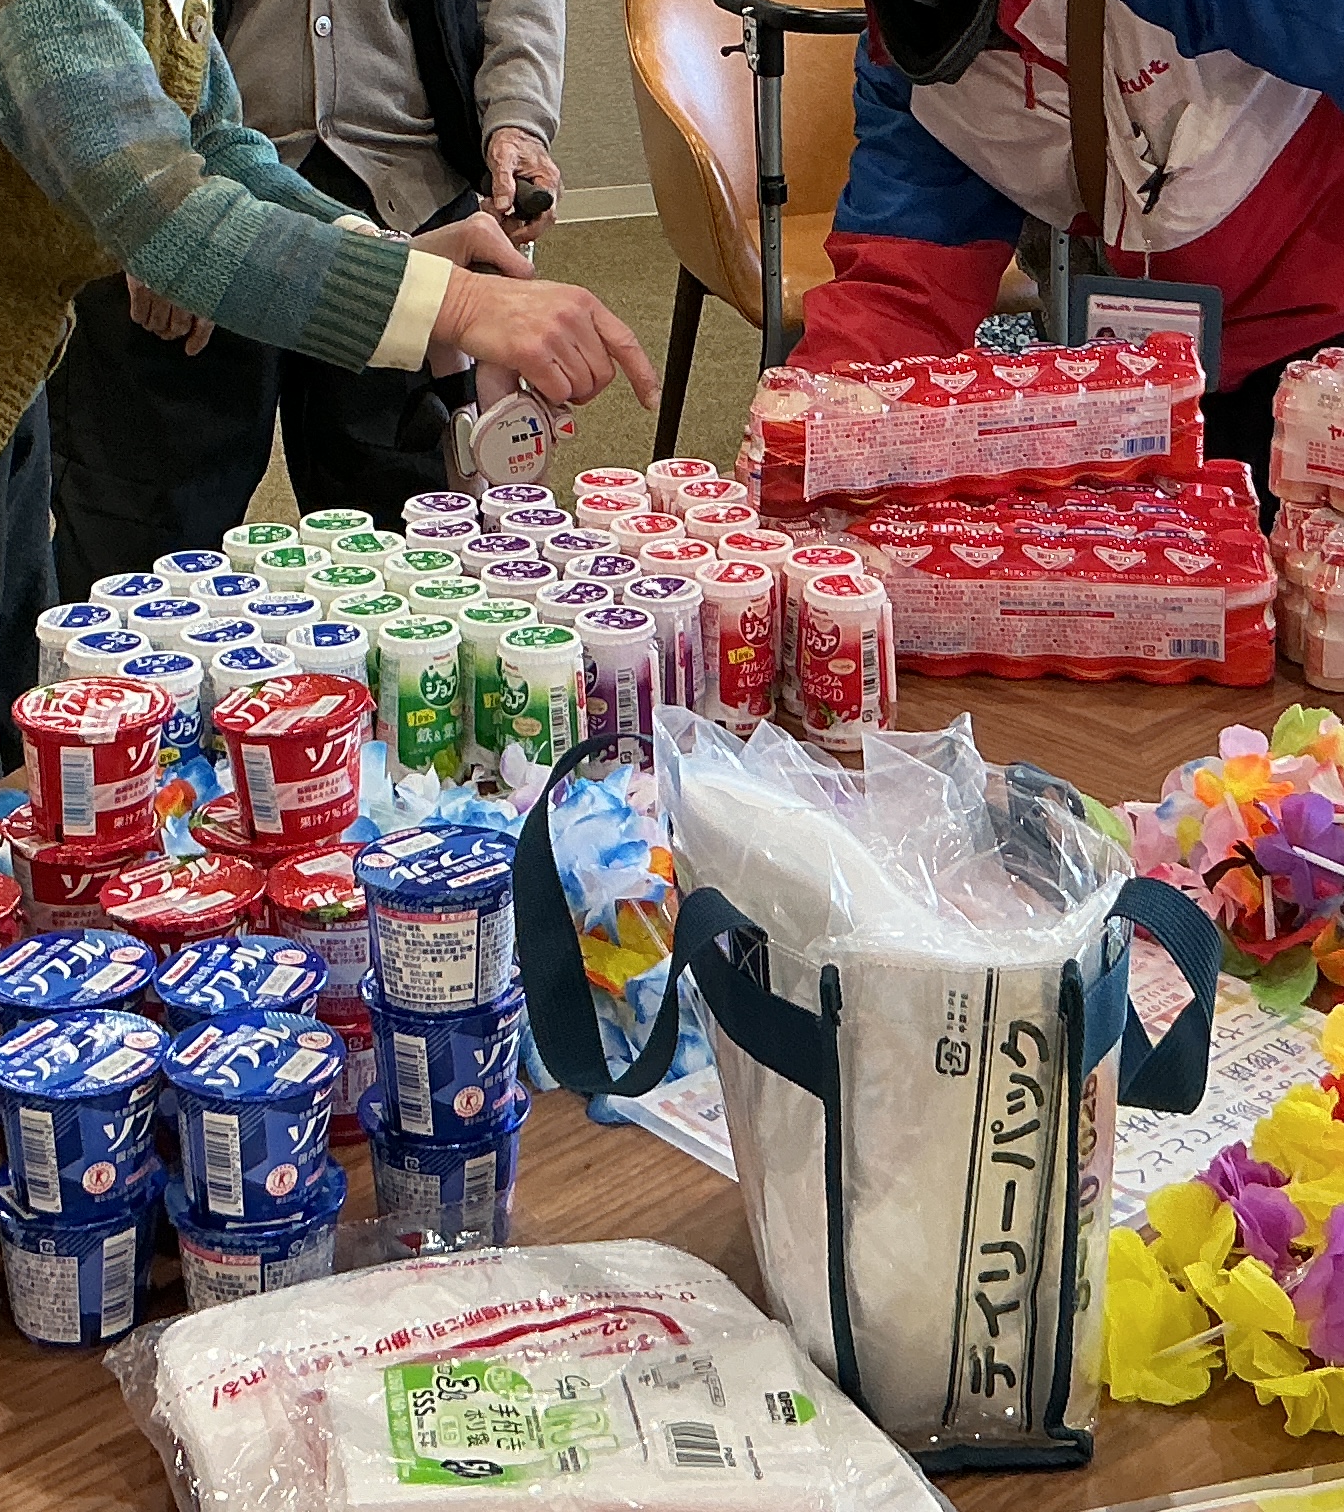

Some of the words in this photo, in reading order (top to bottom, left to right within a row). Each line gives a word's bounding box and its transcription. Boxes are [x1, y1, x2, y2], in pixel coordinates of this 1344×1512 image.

[425, 674, 457, 701] ジョア
[167, 712, 201, 739] ジョア
[13, 939, 106, 996] ソフール
[204, 1023, 291, 1087] ソフール
[969, 1018, 1050, 1399] デイリーパック
[779, 1389, 793, 1426] OPEN
